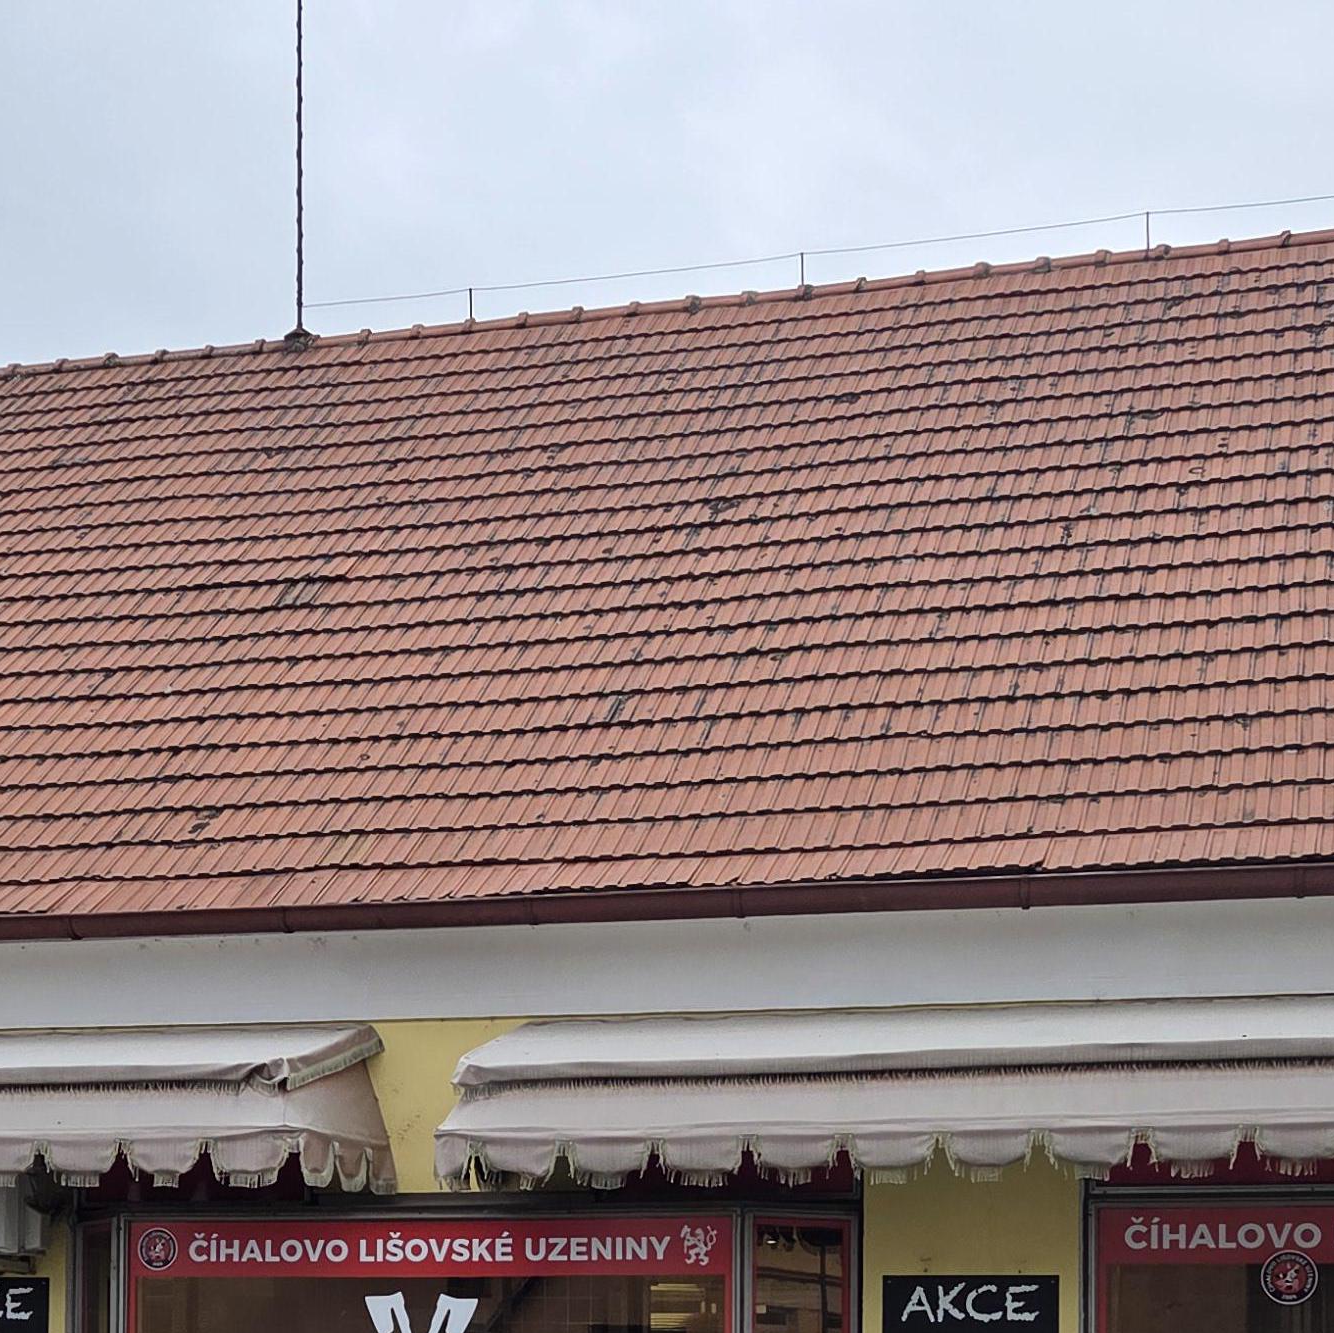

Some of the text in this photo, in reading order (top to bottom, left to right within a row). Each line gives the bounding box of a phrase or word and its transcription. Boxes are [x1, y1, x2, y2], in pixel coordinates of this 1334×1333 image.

[188, 1232, 349, 1264] ČÍHALOVO
[359, 1231, 513, 1263] LIŠOVSKÉ
[524, 1236, 670, 1262] UZENINY
[1124, 1216, 1322, 1250] ČÍHALOVO
[901, 1282, 1040, 1323] AKCE
